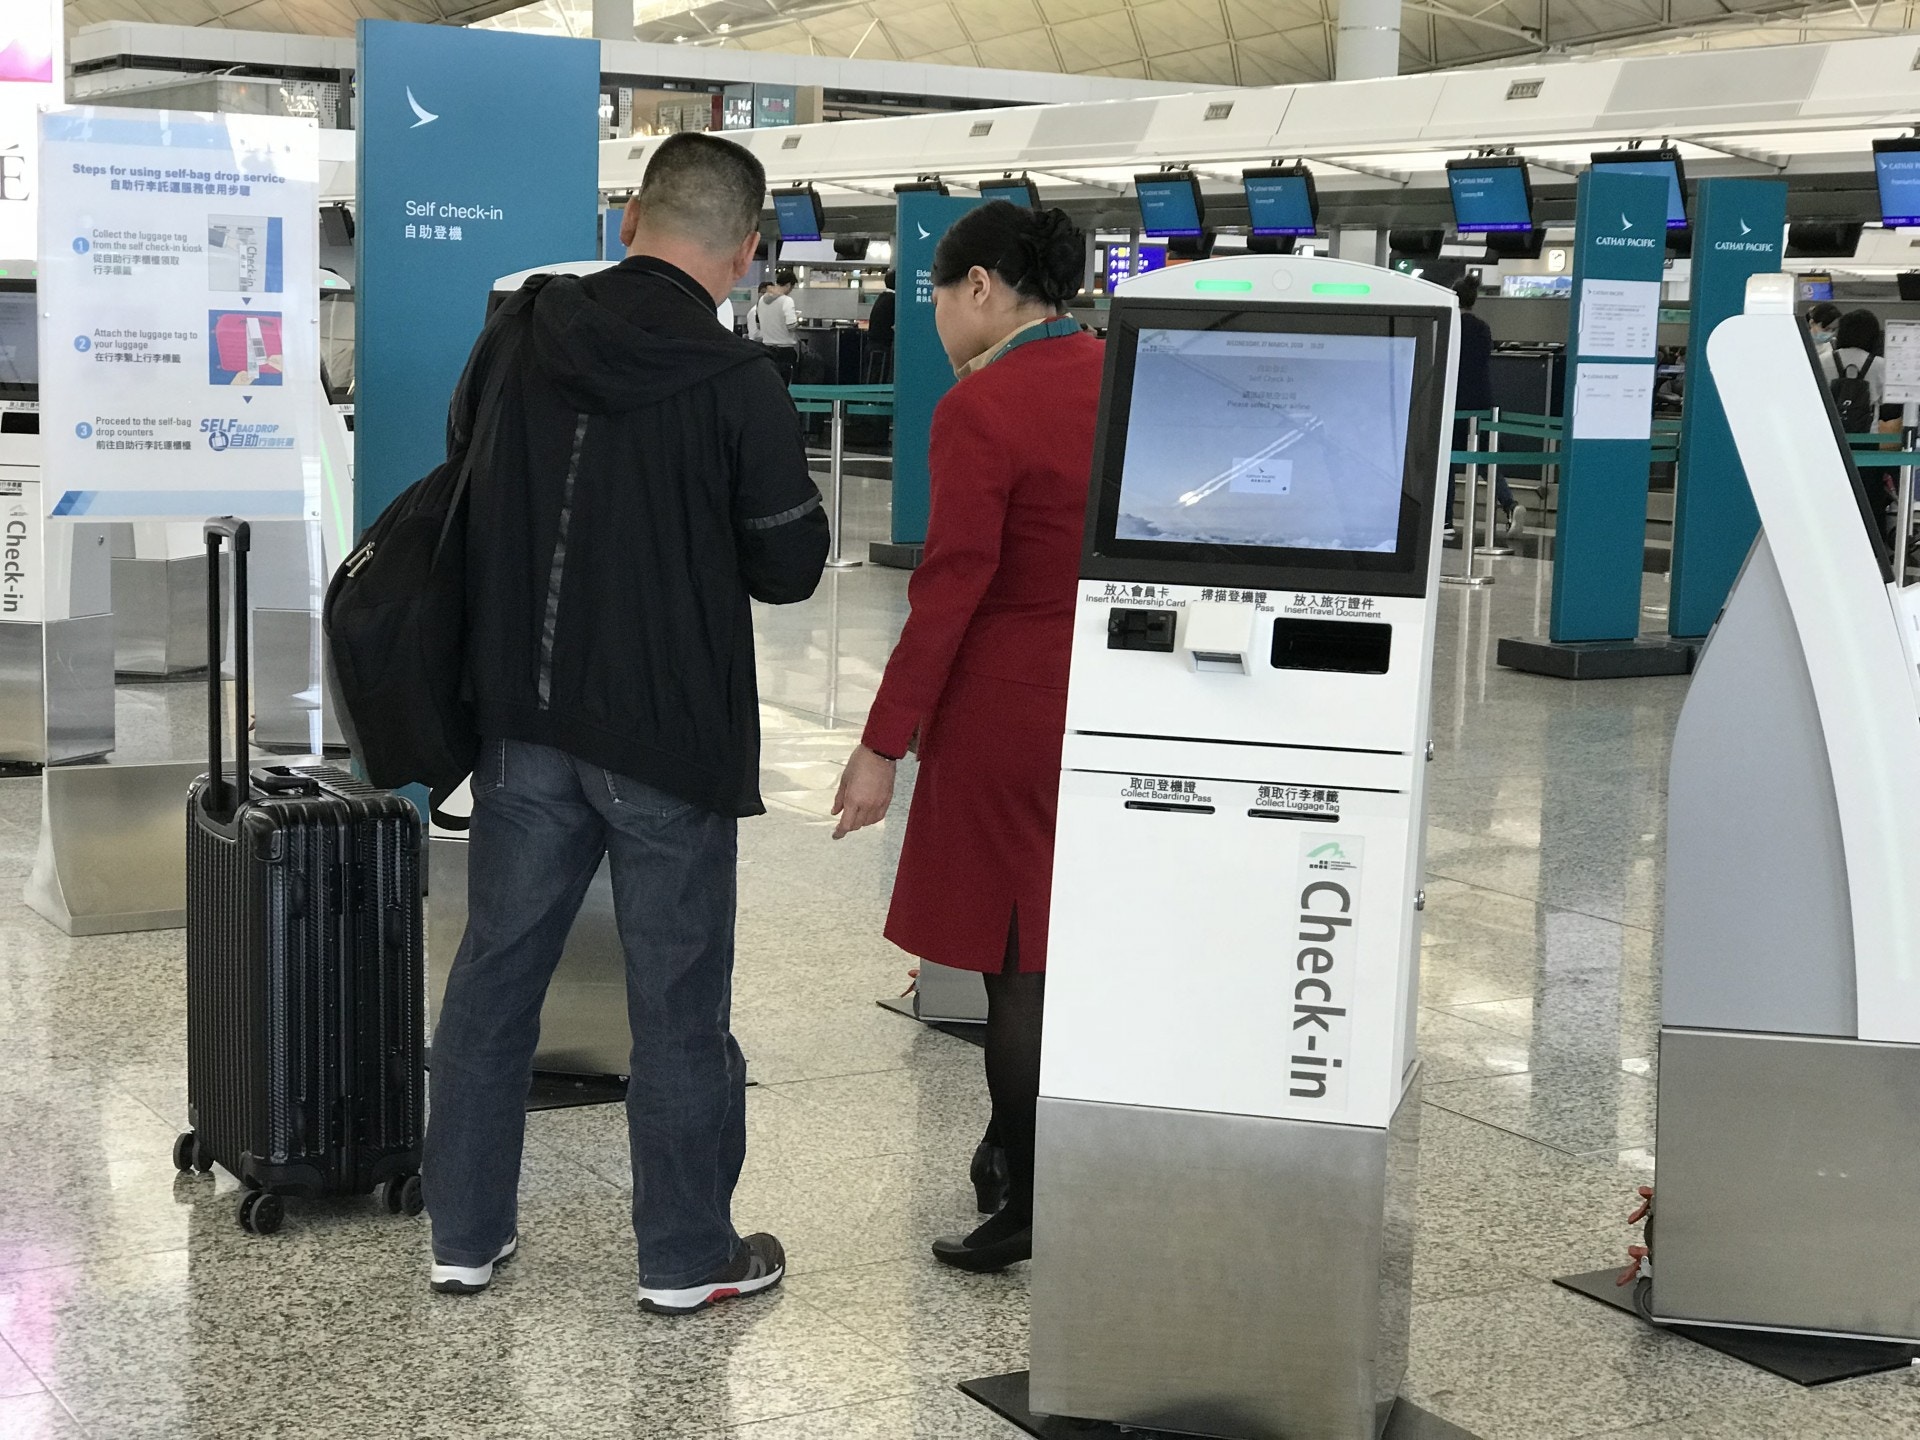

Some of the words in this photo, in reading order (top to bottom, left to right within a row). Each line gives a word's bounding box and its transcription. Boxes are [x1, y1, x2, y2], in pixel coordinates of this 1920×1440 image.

[72, 163, 107, 176] Steps
[110, 165, 126, 176] for
[129, 168, 162, 181] using
[164, 168, 211, 182] self-bag
[214, 170, 240, 184] drop
[243, 173, 285, 184] service
[404, 199, 436, 217] Self
[439, 203, 503, 221] check-in
[92, 228, 122, 239] Collect
[123, 230, 137, 240] the
[139, 231, 172, 242] luggage
[174, 233, 188, 243] tag
[404, 222, 463, 241] 自助登機
[92, 241, 112, 250] from
[113, 241, 127, 250] the
[128, 241, 143, 251] self
[145, 242, 181, 252] check-in
[182, 243, 203, 253] kiosk
[1596, 236, 1627, 246] CATHAY
[1627, 237, 1656, 248] PACIFIC
[1714, 241, 1745, 251] CATHAY
[1745, 242, 1774, 252] PACIFIC
[94, 328, 122, 338] Attach
[124, 329, 138, 338] the
[140, 329, 172, 340] luggage
[174, 331, 188, 341] tag
[190, 331, 198, 339] to
[94, 340, 113, 349] your
[115, 340, 149, 351] luggage
[96, 416, 131, 426] Proceed
[132, 417, 141, 426] to
[142, 417, 156, 426] the
[158, 417, 192, 428] self-bag
[199, 418, 239, 433] SELF
[236, 424, 254, 433] BAG
[255, 424, 279, 433] DROP
[95, 428, 115, 437] drop
[117, 428, 154, 437] counters
[3, 519, 27, 613] Check-in
[1103, 583, 1170, 599] 放入會員卡
[1200, 588, 1268, 604] 掃描登機證
[1085, 594, 1109, 603] Insert
[1110, 595, 1165, 608] Membership
[1166, 598, 1186, 608] Card
[1255, 603, 1275, 613] Pass
[1292, 593, 1375, 611] 放入旅行證件
[1284, 605, 1308, 615] Insert
[1308, 606, 1335, 616] Travel
[1336, 608, 1382, 619] Document
[1129, 776, 1197, 794] 取回登機證
[1120, 788, 1150, 799] Collect
[1151, 790, 1191, 803] Boarding
[1192, 793, 1212, 803] Pass
[1257, 785, 1340, 804] 領取行李標籤
[1255, 797, 1285, 808] Collect
[1286, 799, 1325, 812] Luggage
[1325, 802, 1340, 814] Tag
[1289, 880, 1352, 1099] Check-in
